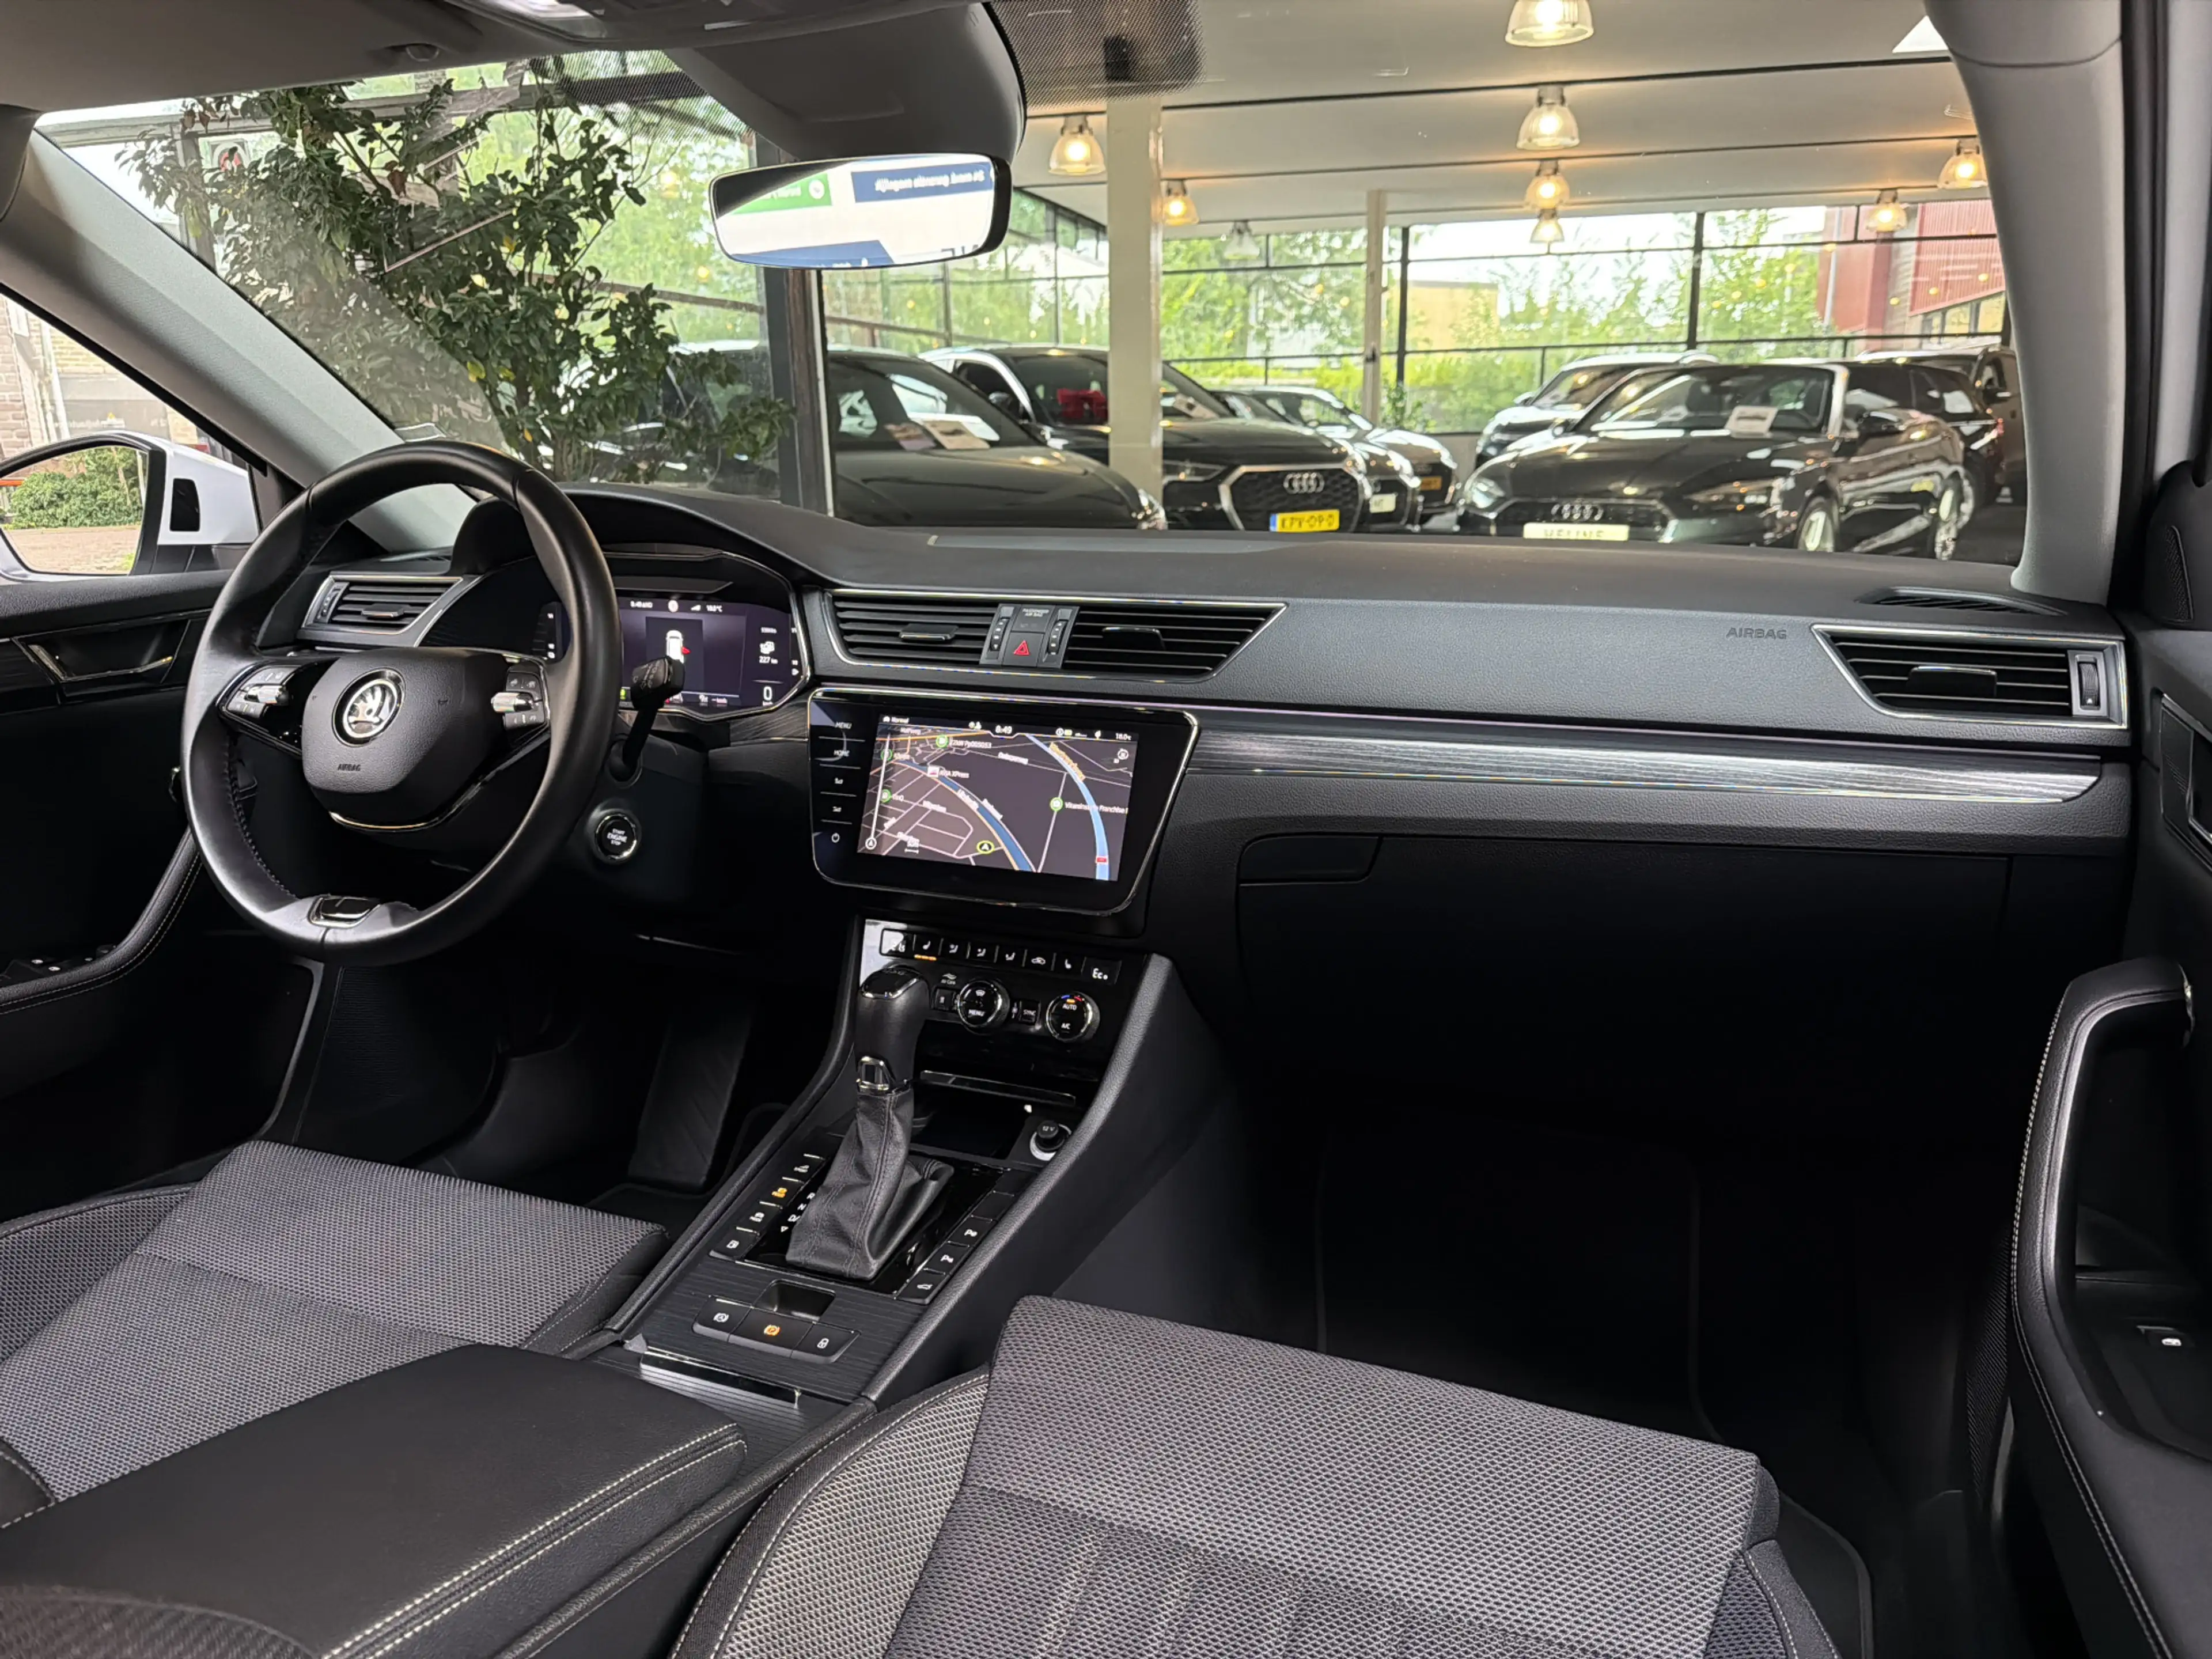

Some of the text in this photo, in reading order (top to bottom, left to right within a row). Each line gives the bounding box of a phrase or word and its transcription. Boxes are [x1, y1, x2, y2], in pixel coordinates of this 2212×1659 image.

[1725, 627, 1787, 640] AIRBAG
[995, 725, 1012, 734] 8:49
[338, 763, 361, 771] AIRBAG
[1062, 1003, 1078, 1012] AUTO
